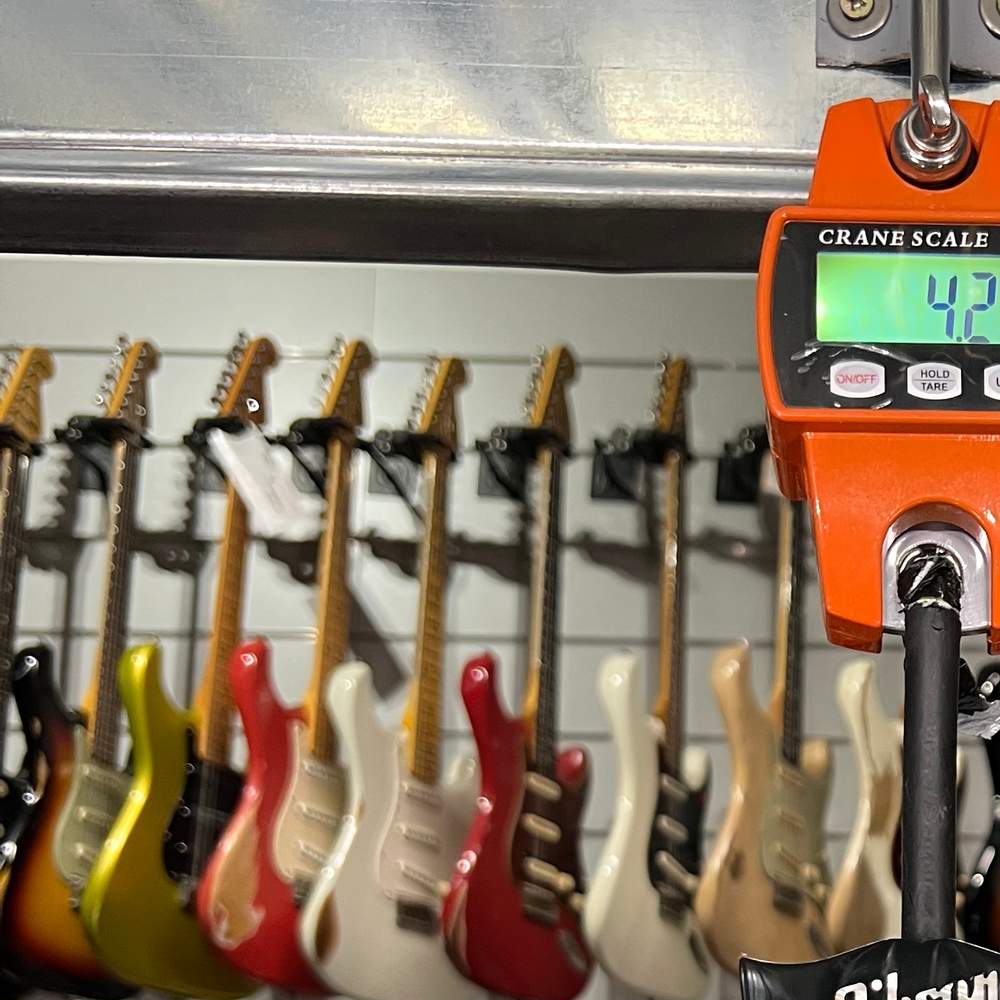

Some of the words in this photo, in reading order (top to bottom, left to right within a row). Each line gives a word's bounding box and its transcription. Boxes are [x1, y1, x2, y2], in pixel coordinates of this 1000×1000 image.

[818, 229, 905, 247] CRANE
[911, 231, 989, 248] SCALE
[836, 374, 878, 384] ON/OFF
[920, 369, 950, 379] HOLD
[921, 382, 948, 392] TARE
